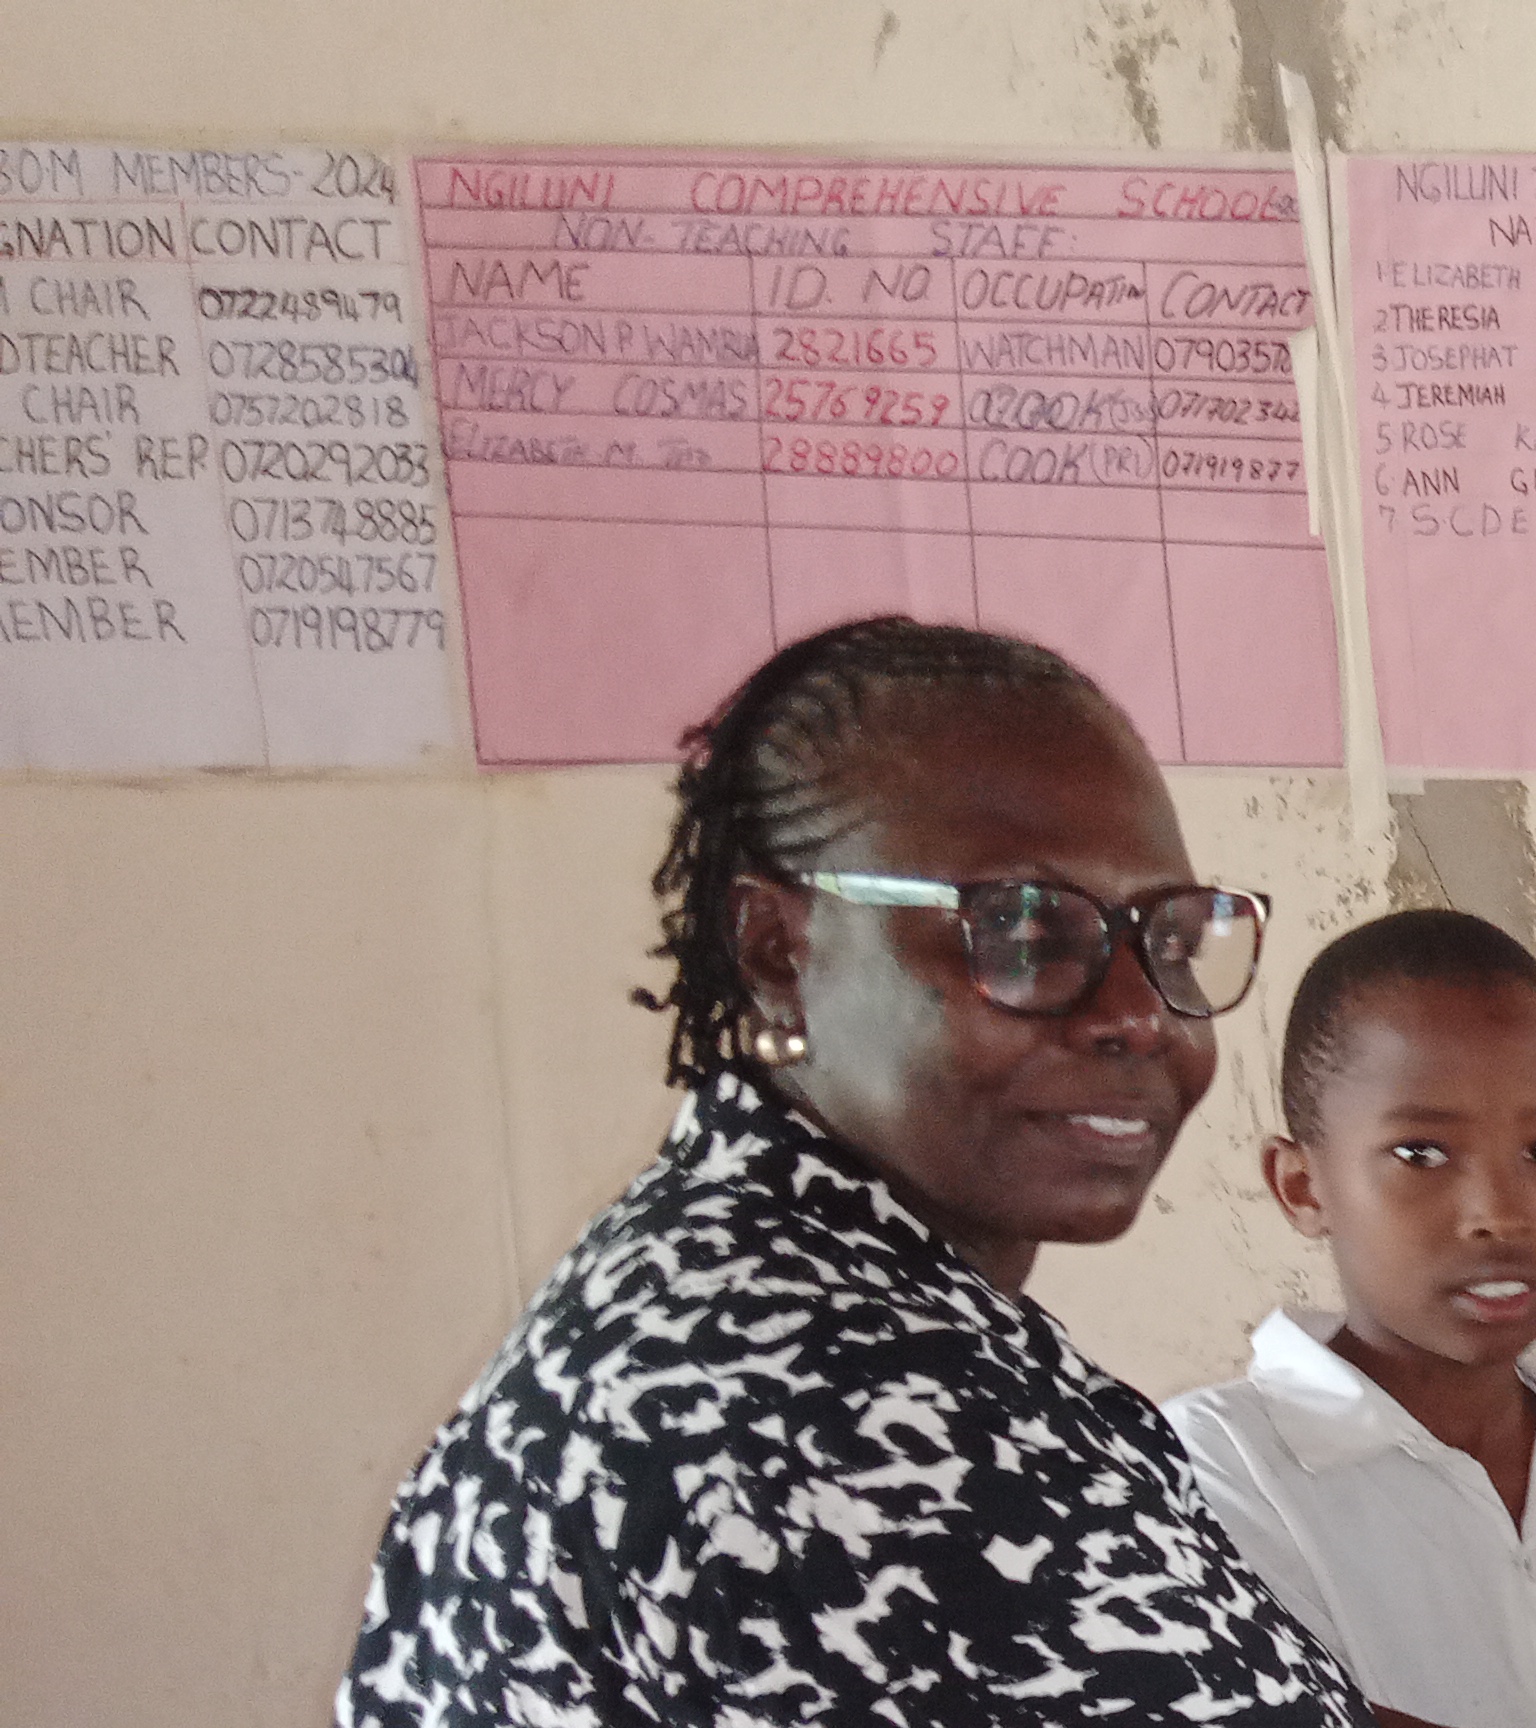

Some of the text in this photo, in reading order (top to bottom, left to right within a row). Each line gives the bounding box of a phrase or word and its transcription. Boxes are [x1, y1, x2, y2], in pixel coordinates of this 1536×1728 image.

[1395, 162, 1518, 204] NGILUNI
[190, 216, 392, 262] CONTACT
[30, 277, 151, 322] CHAIR
[450, 259, 592, 301] NAME
[1161, 270, 1312, 319] CONTACT
[962, 333, 1144, 370] WATCHMAN
[1396, 343, 1518, 373] JOSEPHAT
[22, 383, 140, 426] CHAIR
[1402, 421, 1468, 453] ROSE
[1402, 465, 1461, 497] ANN
